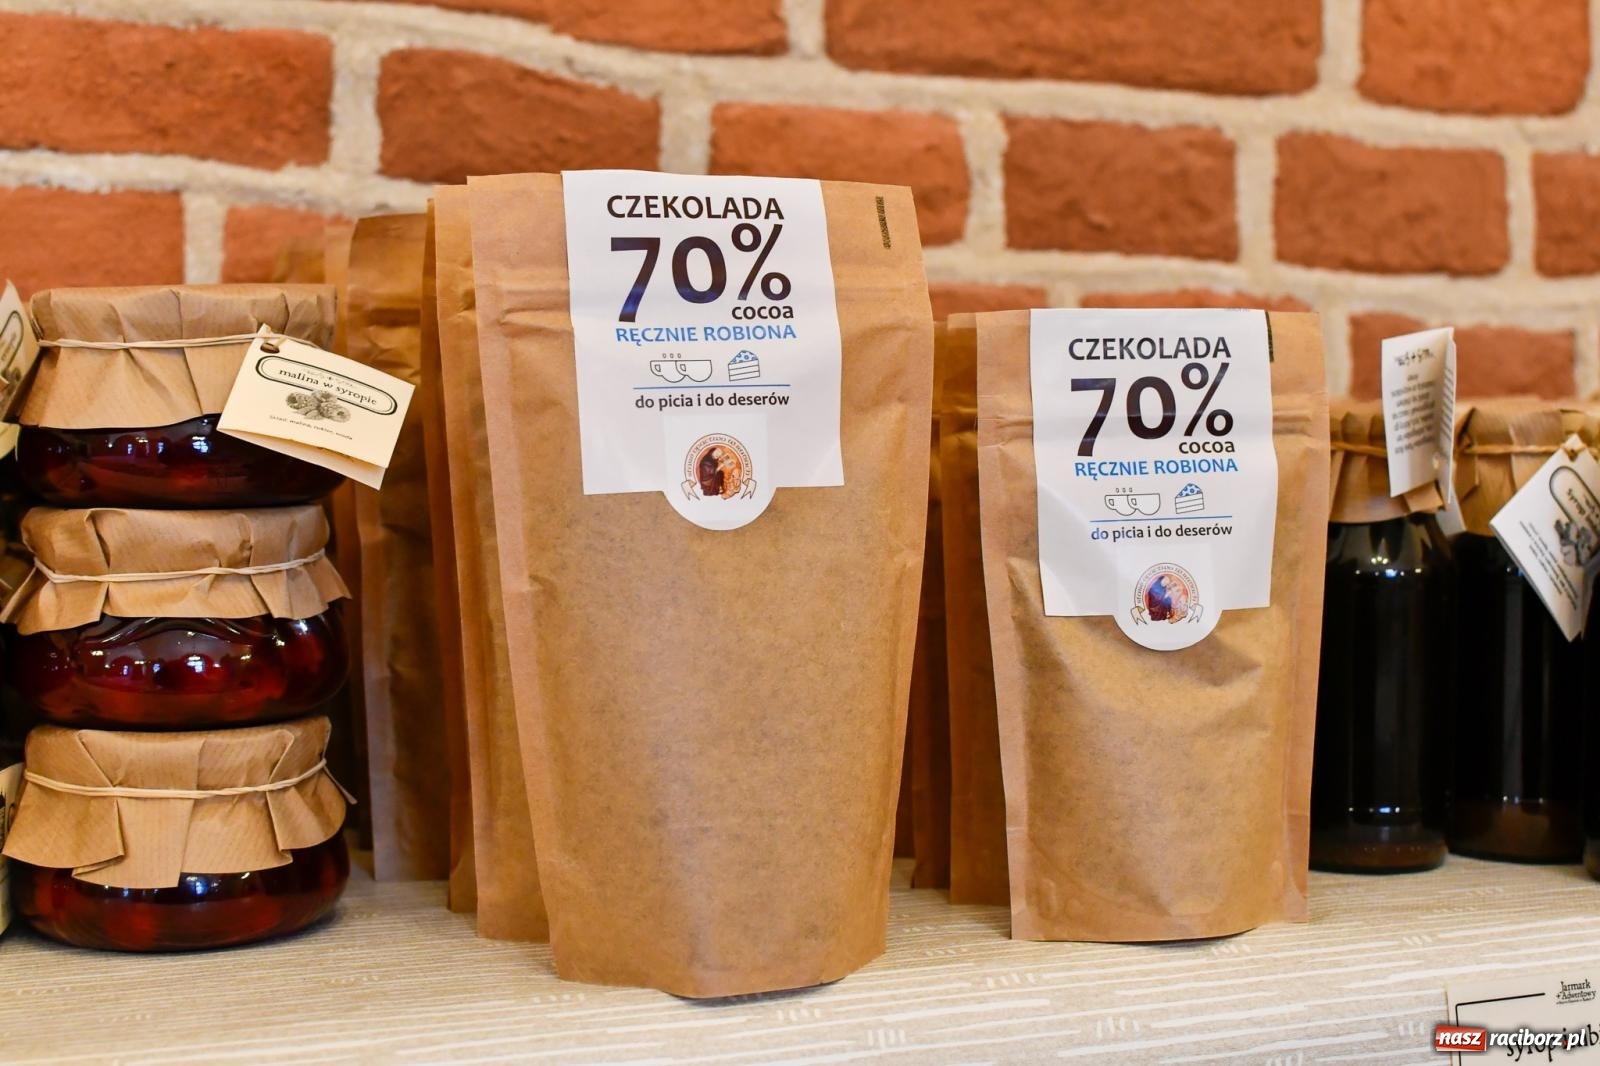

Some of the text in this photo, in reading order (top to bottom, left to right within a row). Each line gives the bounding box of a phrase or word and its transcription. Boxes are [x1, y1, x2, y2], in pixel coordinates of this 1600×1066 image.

[607, 195, 785, 220] CZEKOLADA
[610, 222, 792, 323] 70%
[731, 305, 795, 320] cocoa
[616, 324, 797, 346] RĘCZNIE ROBIONA
[1068, 336, 1232, 361] CZEKOLADA
[279, 369, 319, 385] malina
[323, 381, 334, 389] w
[635, 391, 790, 411] do picia i do deserów
[1071, 362, 1234, 457] 70%
[1179, 441, 1236, 455] cocoa
[1074, 458, 1239, 480] RĘCZNIE ROBIONA
[1091, 523, 1233, 542] do picia i do deserów
[1559, 979, 1592, 993] Jarmark
